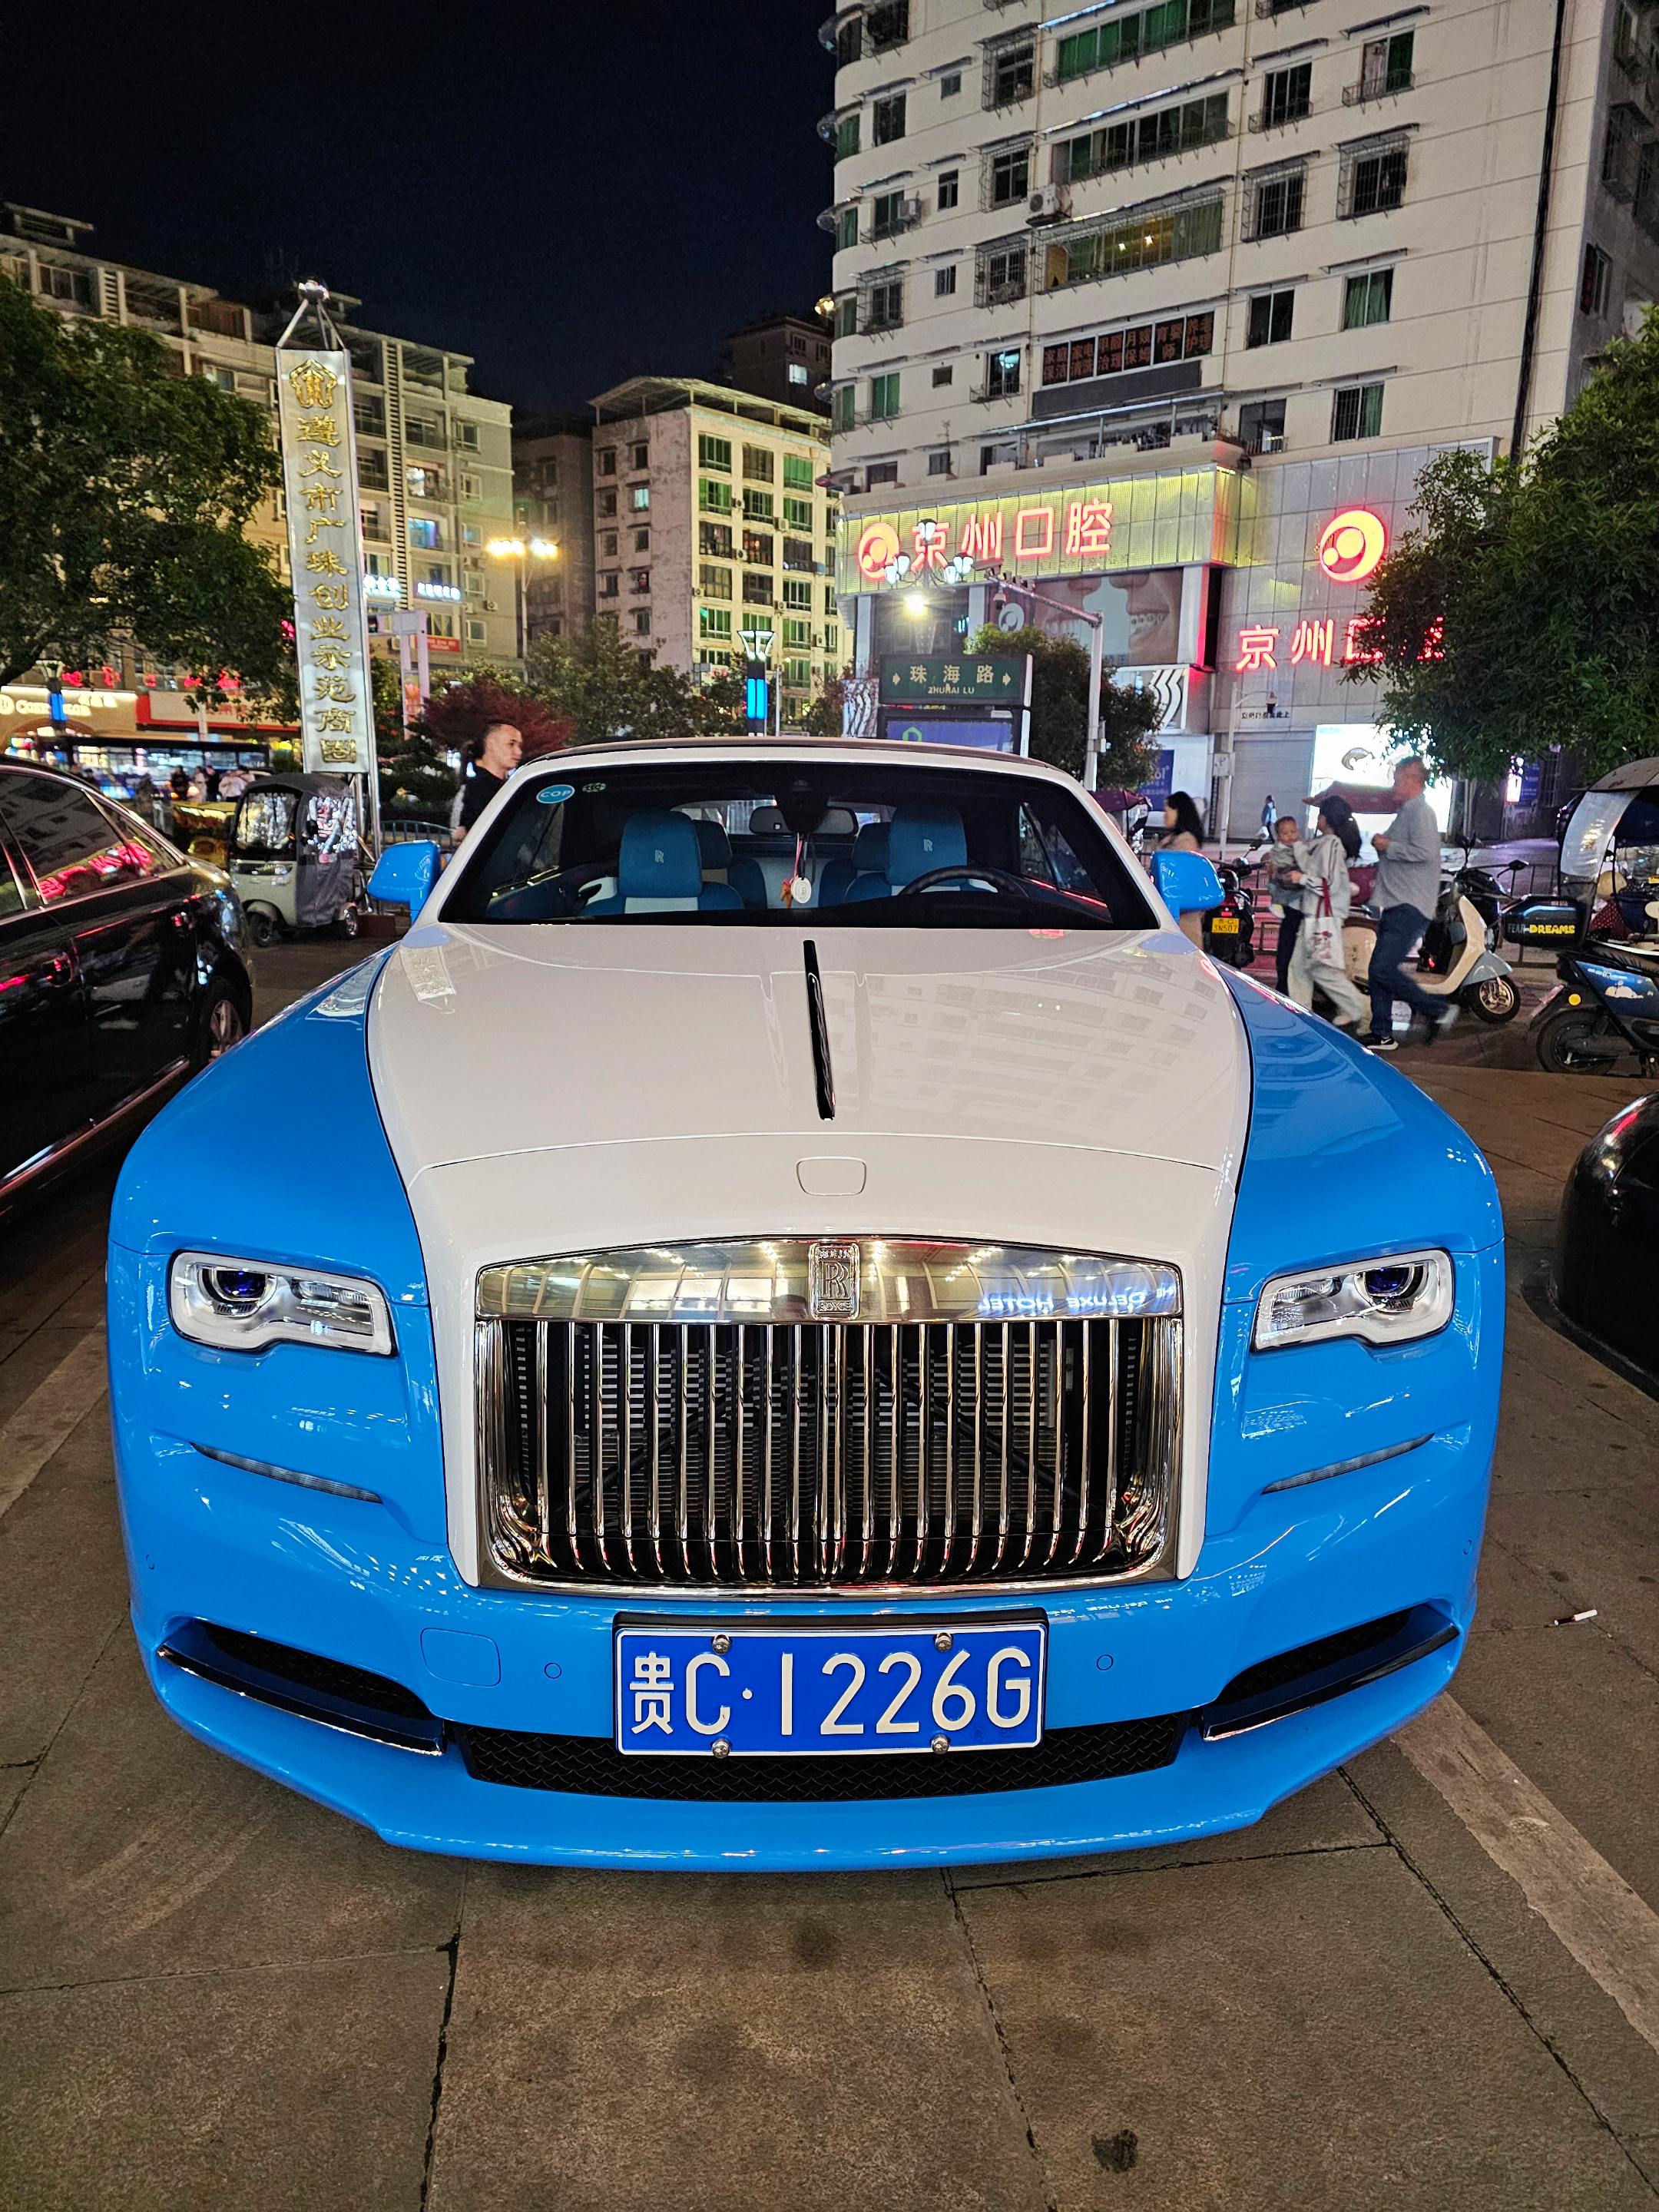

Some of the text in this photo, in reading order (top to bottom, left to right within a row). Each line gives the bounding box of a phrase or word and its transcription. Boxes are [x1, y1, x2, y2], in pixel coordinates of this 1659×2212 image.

[909, 496, 1114, 575] 京州口腔
[295, 415, 358, 764] 遵义市广珠创业示范商圈
[909, 664, 994, 684] 珠海路
[963, 686, 975, 694] LU
[540, 790, 571, 798] COP
[629, 1644, 1031, 1736] 贵C·1226G
